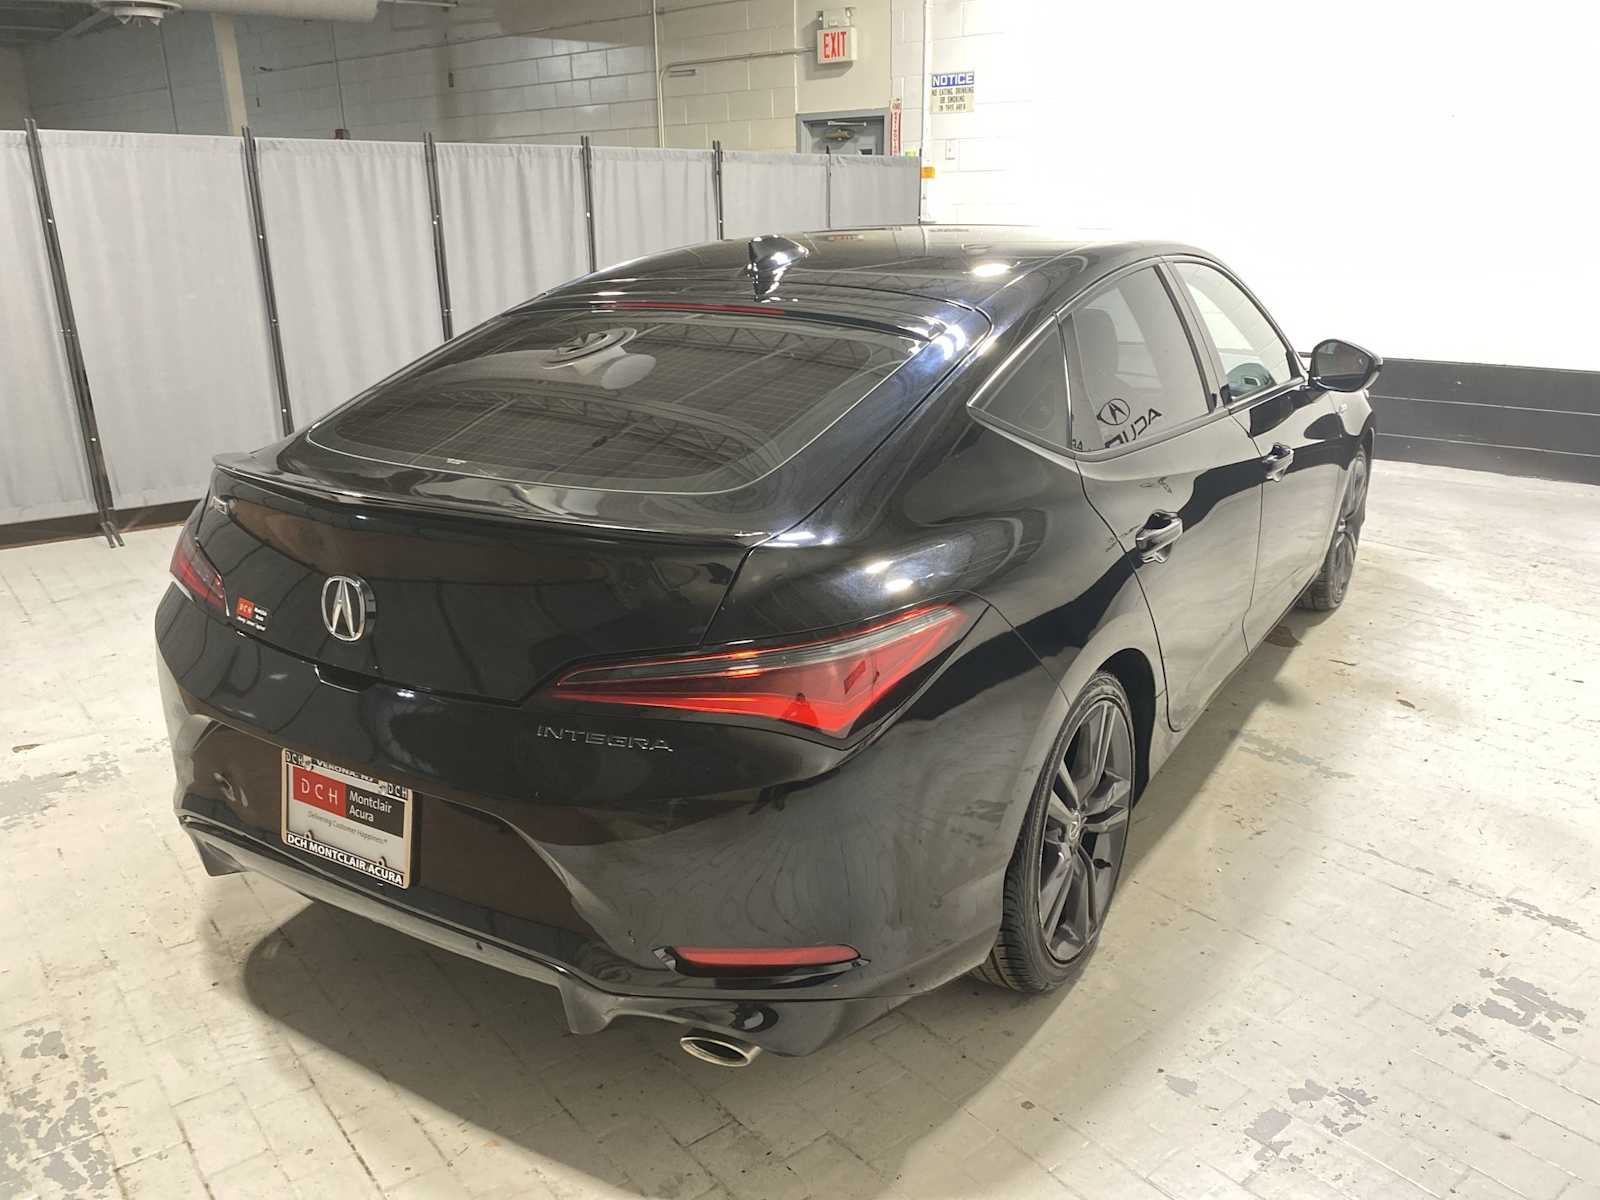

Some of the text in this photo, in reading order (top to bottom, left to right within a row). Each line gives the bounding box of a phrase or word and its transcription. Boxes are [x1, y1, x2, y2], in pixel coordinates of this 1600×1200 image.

[823, 31, 847, 58] EXIT
[932, 72, 974, 87] NOTICE
[536, 725, 674, 752] INTEGRA
[301, 778, 338, 806] DCH
[349, 790, 393, 813] Montclair
[388, 783, 409, 798] DCH
[349, 805, 375, 823] Acura
[287, 833, 403, 885] DCH MONTCLAIR ACURA
